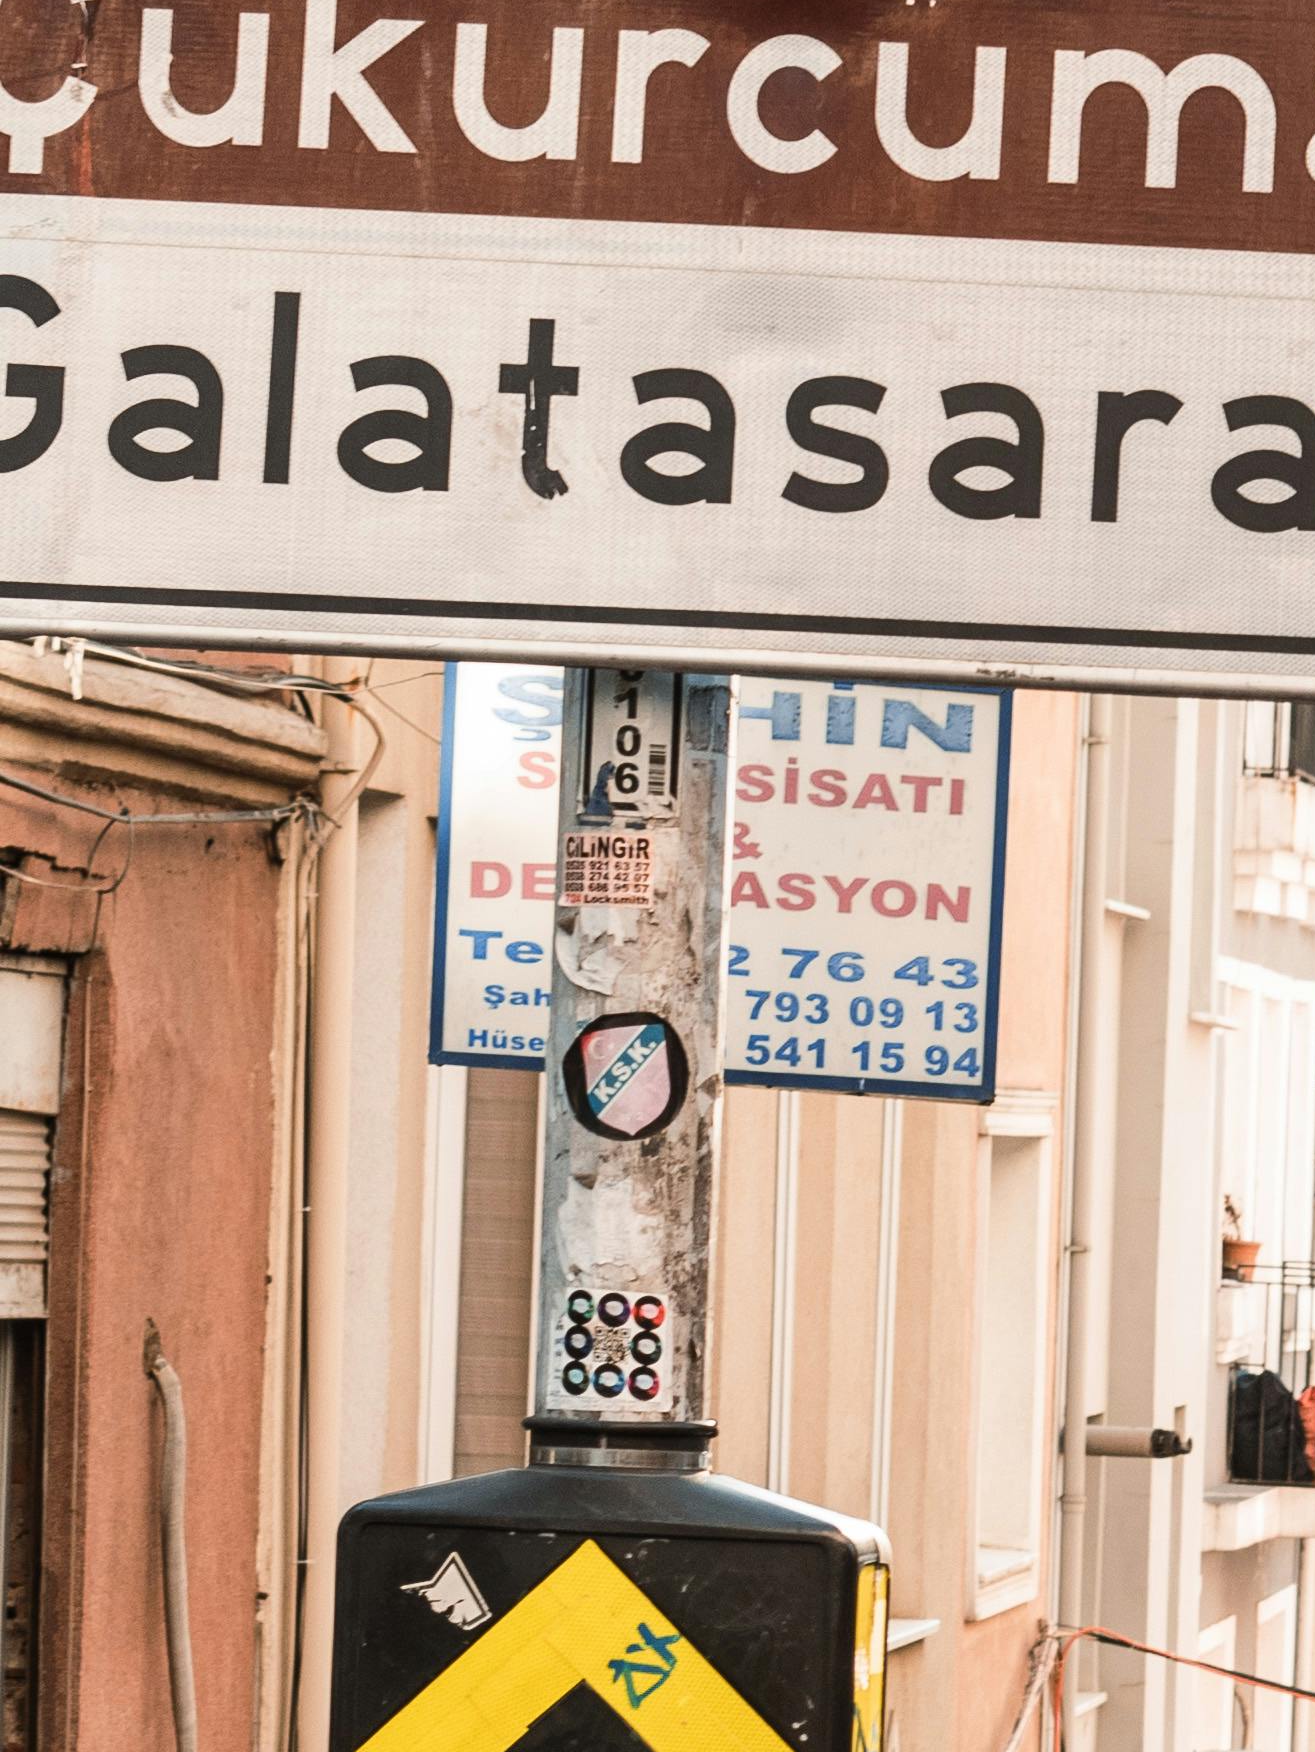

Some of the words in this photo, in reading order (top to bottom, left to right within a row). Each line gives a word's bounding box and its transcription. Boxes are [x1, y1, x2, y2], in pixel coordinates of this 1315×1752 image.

[583, 894, 650, 905] Locksmith
[458, 928, 544, 964] Te
[781, 948, 865, 983] 76
[894, 956, 979, 989] 43
[745, 989, 829, 1025] 793
[850, 996, 904, 1029] 09
[925, 1001, 979, 1033] 13
[745, 1034, 826, 1068] 541
[852, 1040, 905, 1073] 15
[924, 1044, 981, 1077] 94
